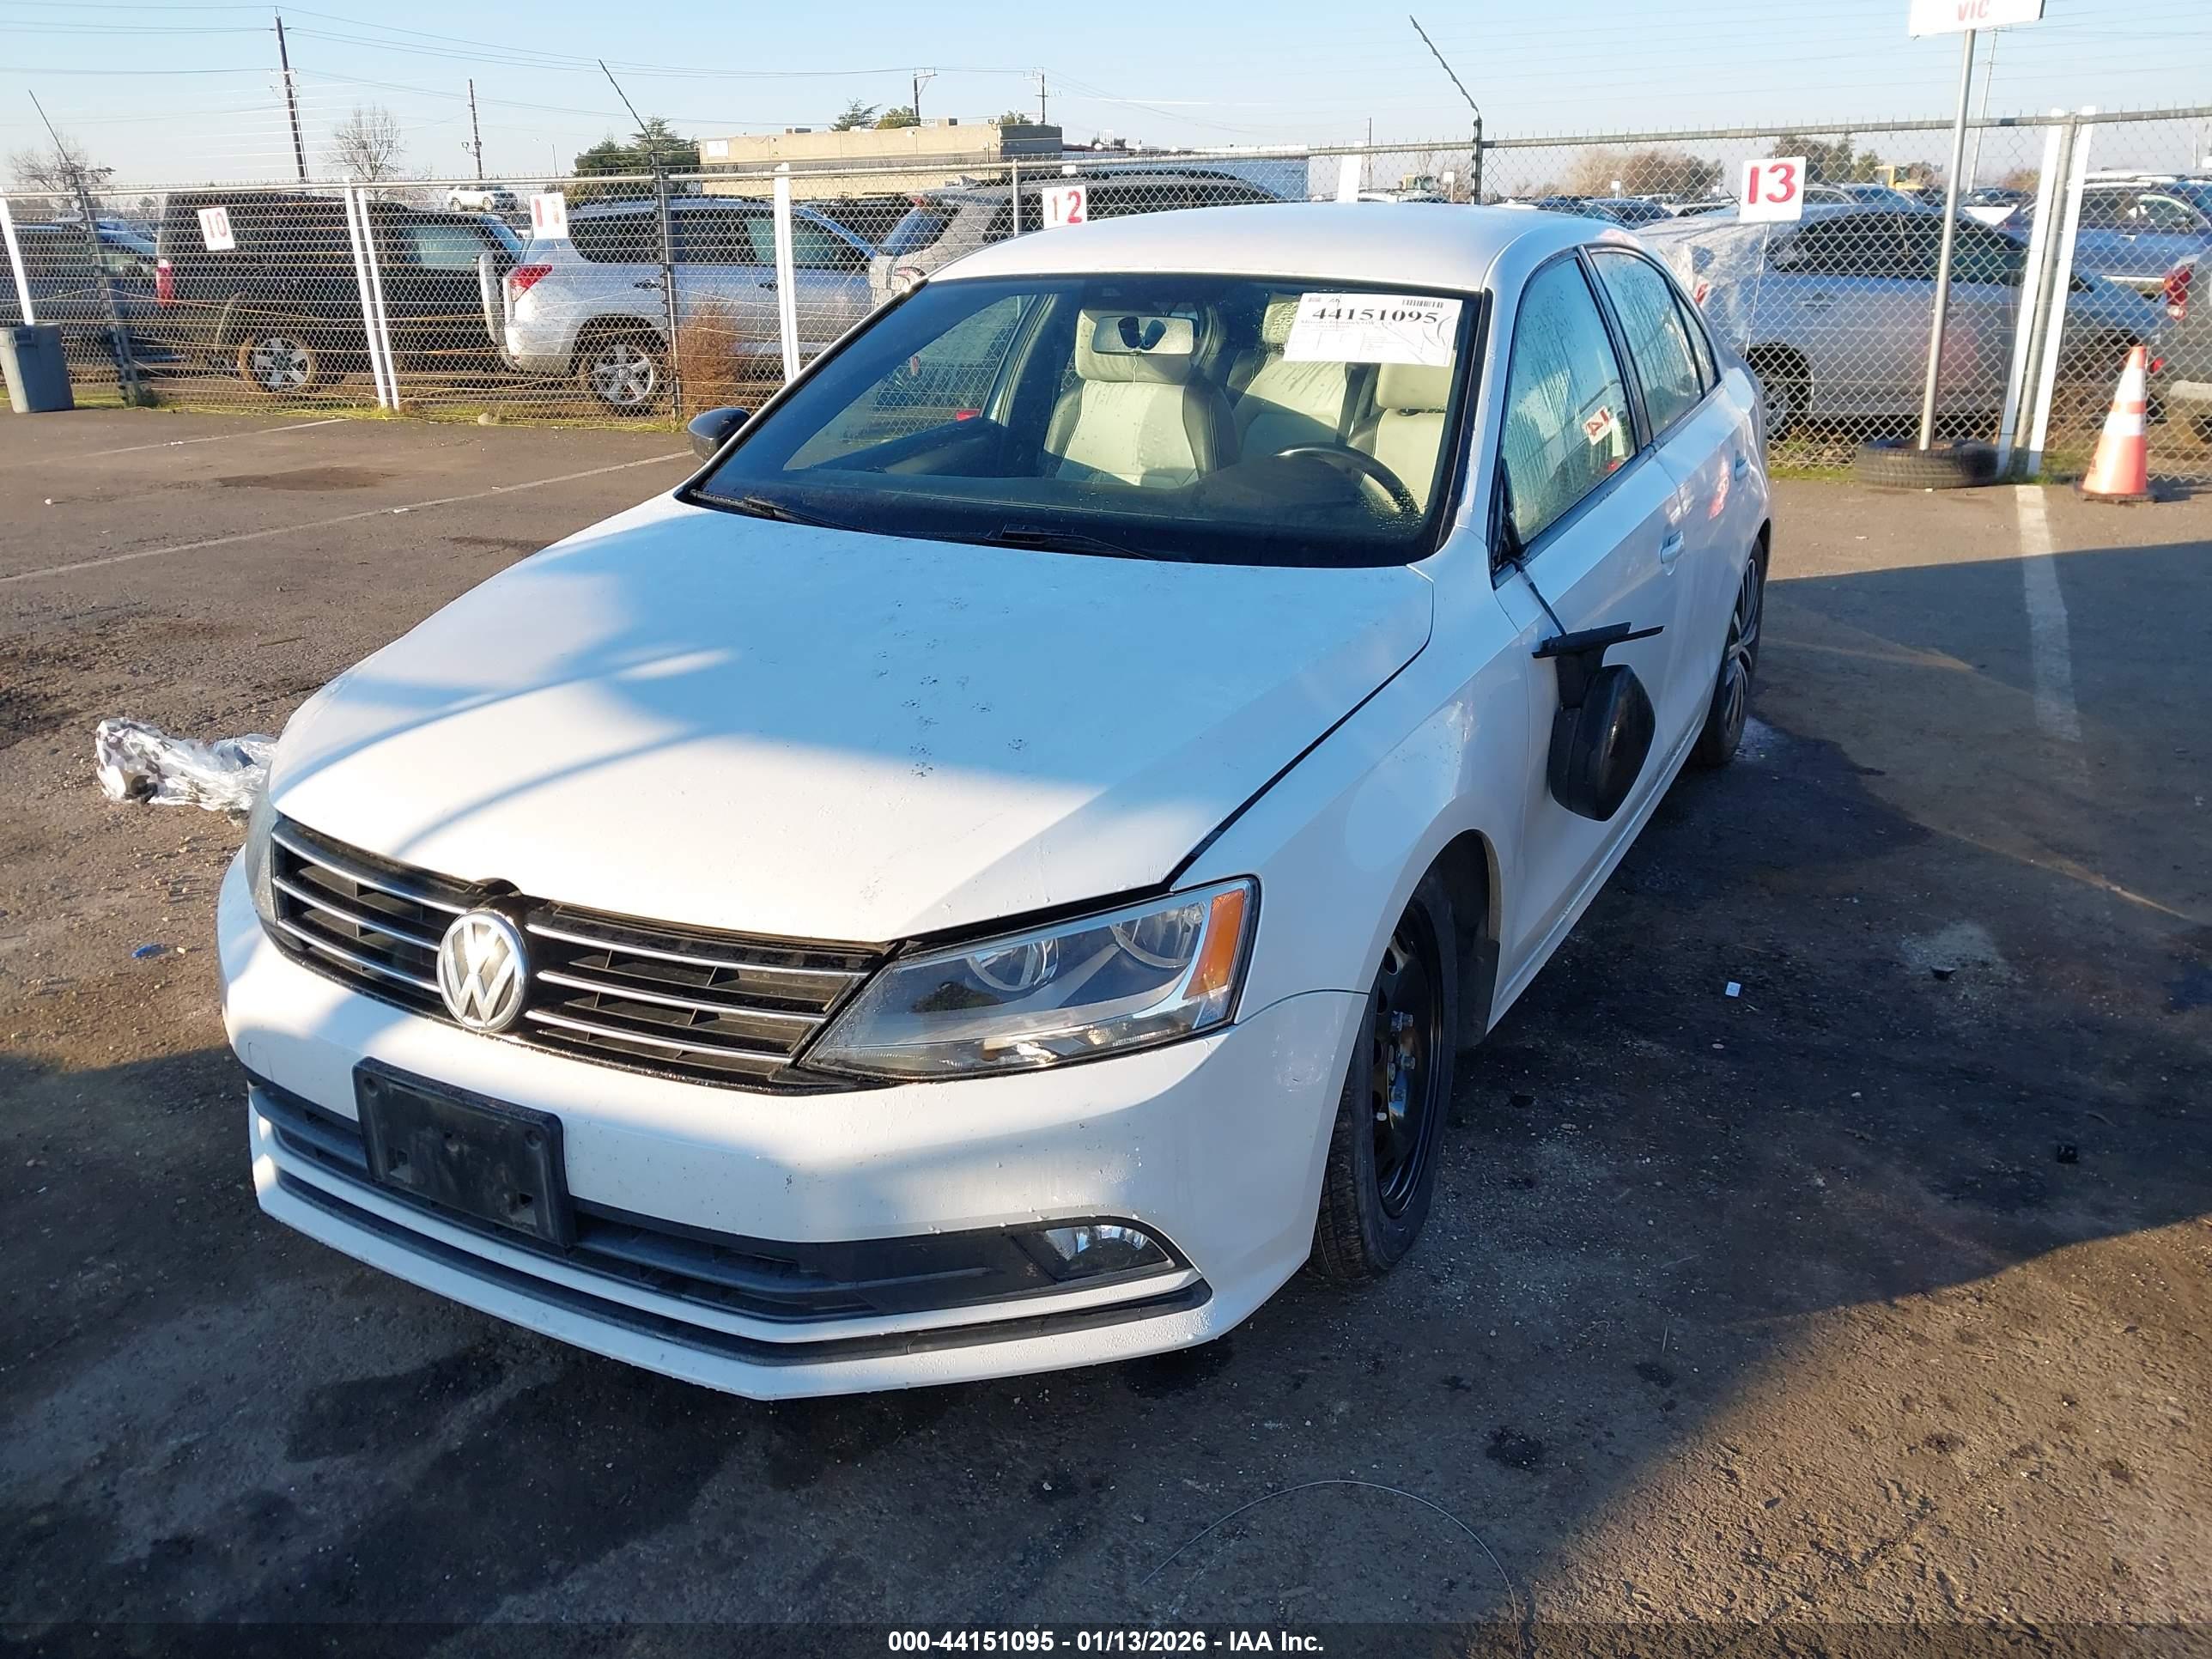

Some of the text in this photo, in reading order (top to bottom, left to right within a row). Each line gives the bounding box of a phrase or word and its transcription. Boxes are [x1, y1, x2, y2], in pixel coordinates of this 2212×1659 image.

[1748, 162, 1796, 204] 13
[1053, 191, 1083, 224] 12
[206, 211, 228, 239] 10
[1312, 307, 1439, 325] 44151095
[440, 915, 521, 1029] VW
